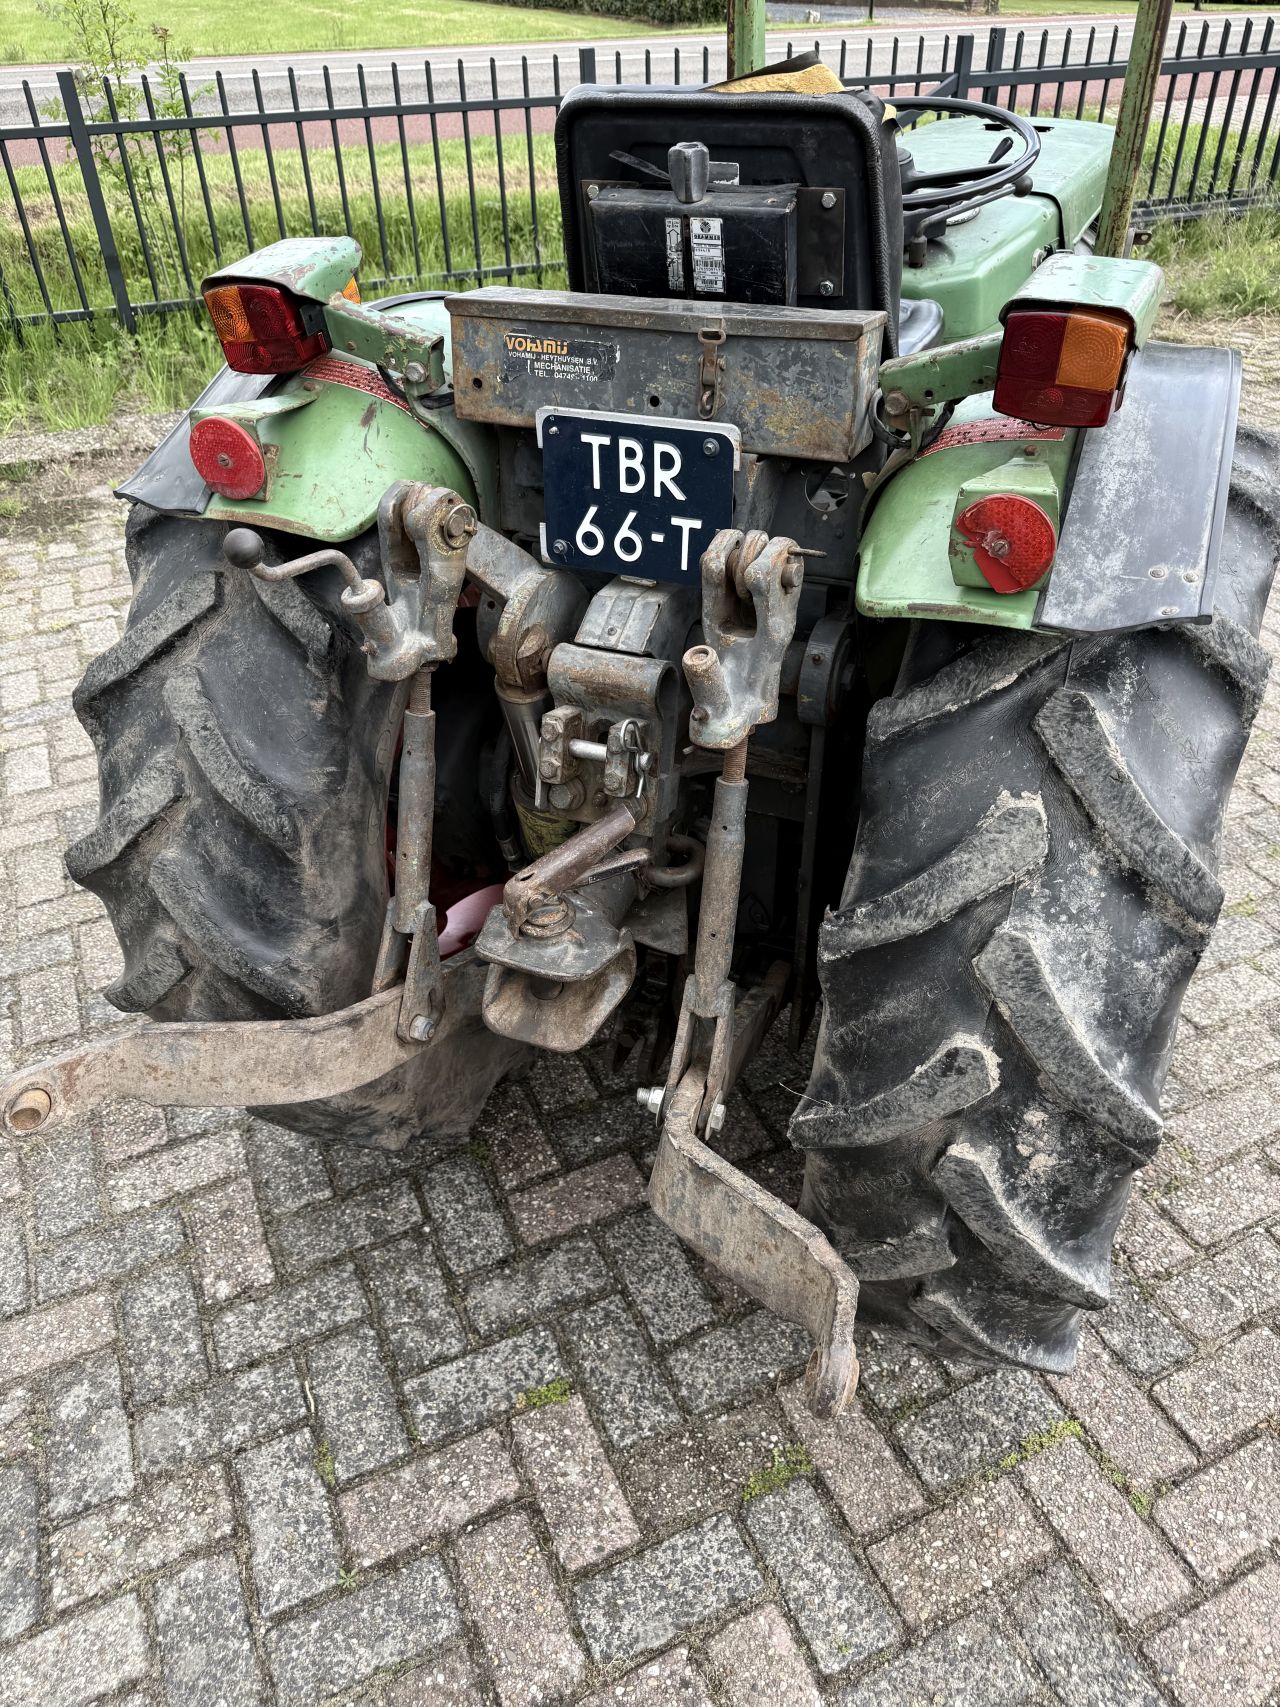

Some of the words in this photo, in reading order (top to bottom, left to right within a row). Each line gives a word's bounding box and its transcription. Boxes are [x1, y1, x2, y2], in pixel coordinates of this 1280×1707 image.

[508, 351, 536, 360] VOHAMIJ
[540, 354, 584, 364] HEYTHUYSEN
[534, 361, 591, 374] MECHANISATIE
[580, 432, 687, 501] TBR
[575, 504, 703, 571] 66-T
